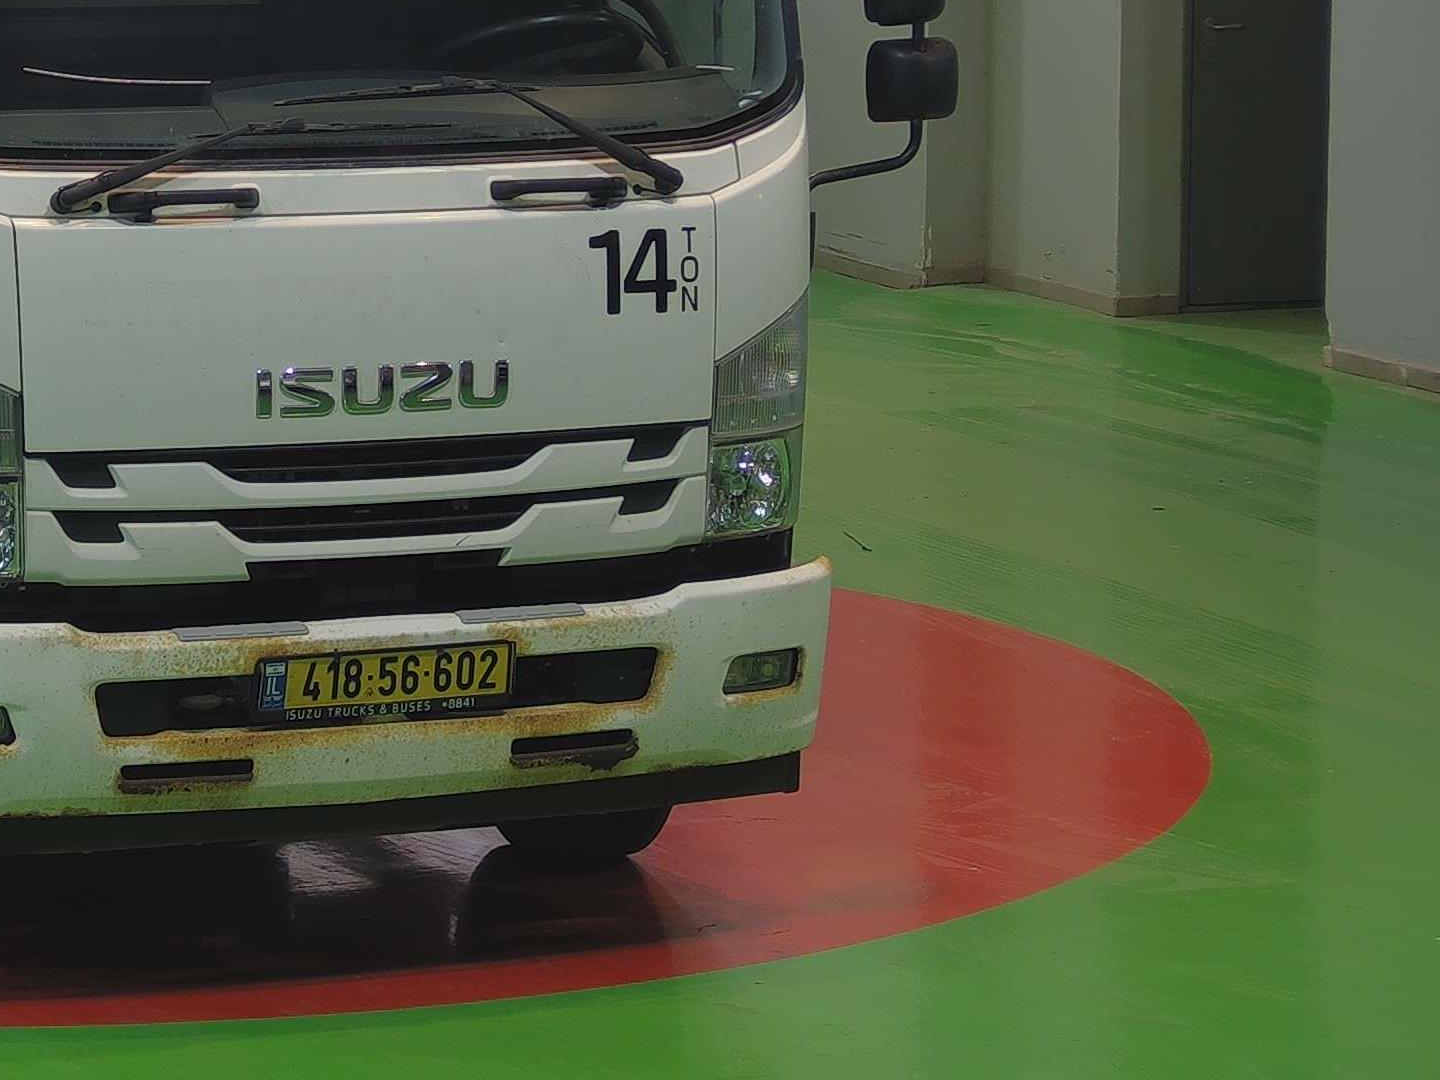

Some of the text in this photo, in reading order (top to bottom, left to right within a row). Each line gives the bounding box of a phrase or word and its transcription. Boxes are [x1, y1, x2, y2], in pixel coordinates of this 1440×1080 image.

[589, 228, 677, 315] 14
[680, 226, 699, 313] TON
[255, 359, 510, 420] ISUZU
[266, 676, 281, 697] IL
[285, 708, 323, 721] ISUZU
[327, 705, 375, 718] TRUCKS
[379, 704, 388, 715] &
[392, 700, 432, 713] BUSES
